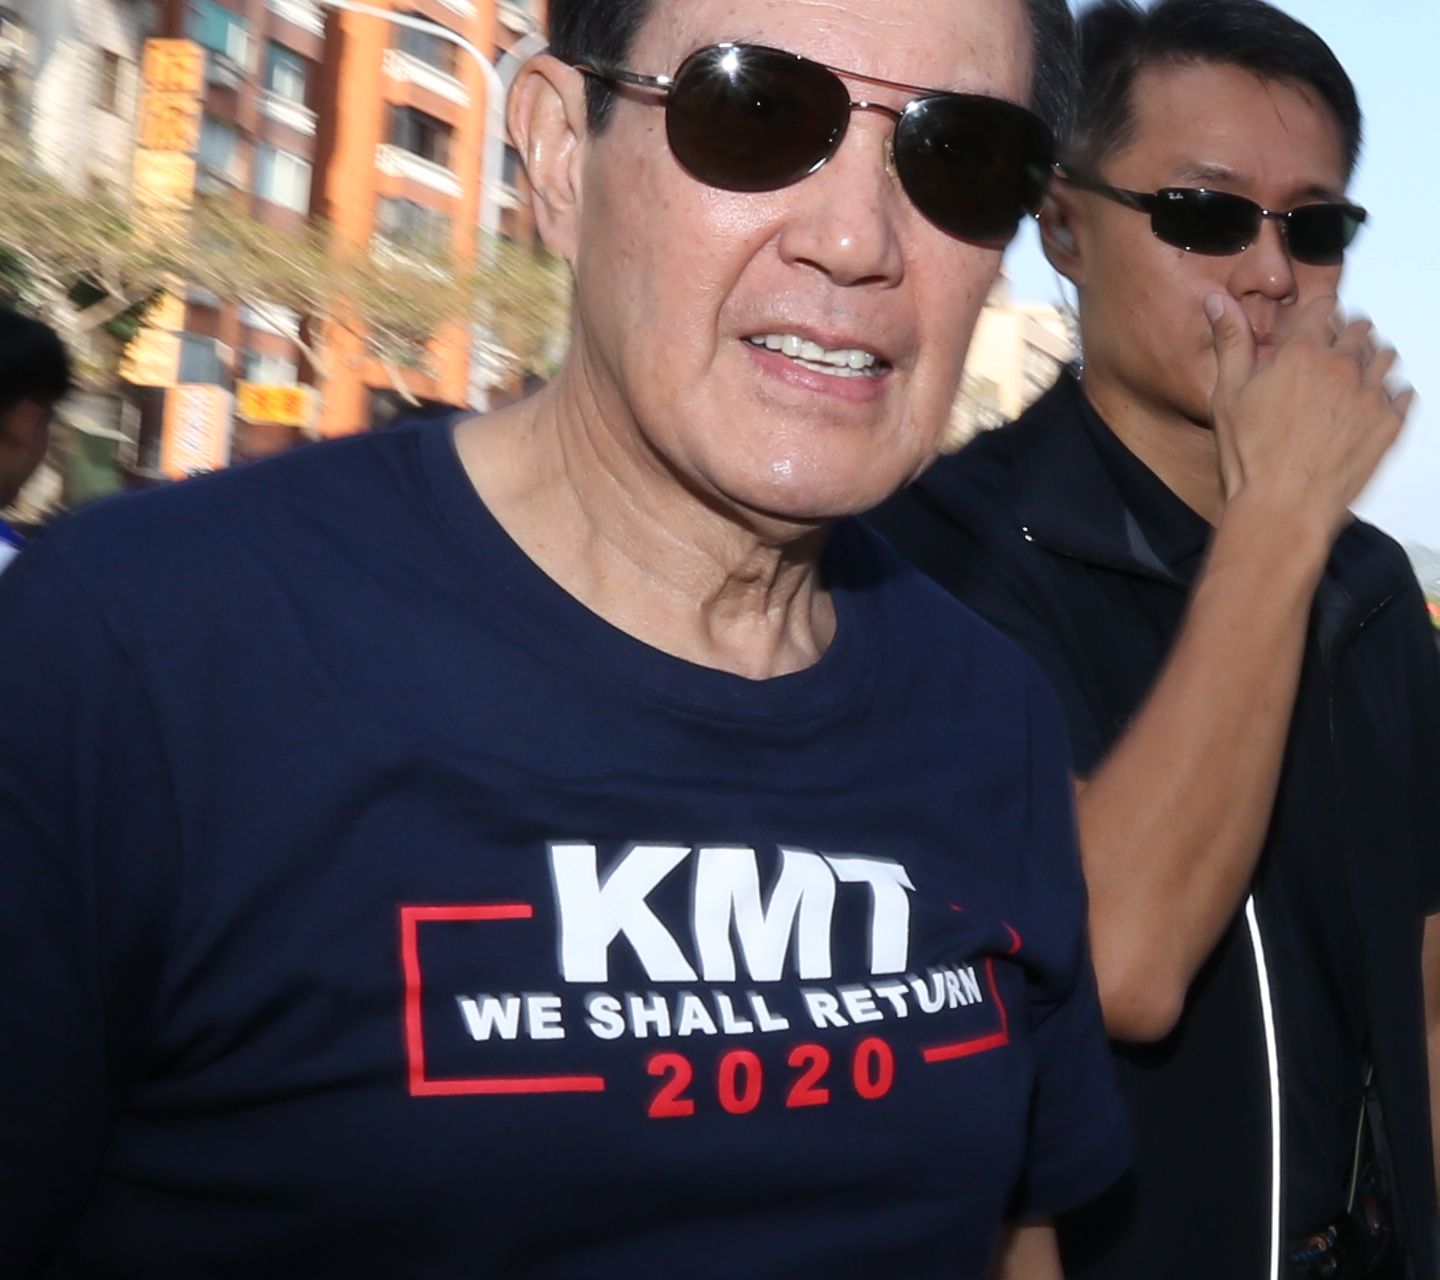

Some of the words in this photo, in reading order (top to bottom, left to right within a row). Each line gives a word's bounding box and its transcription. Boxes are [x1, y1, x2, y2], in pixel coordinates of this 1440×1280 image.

[549, 842, 916, 983] KMT
[459, 995, 564, 1041] WE
[587, 990, 789, 1038] SHALL
[804, 966, 983, 1029] RETURN
[647, 1037, 894, 1118] 2020
